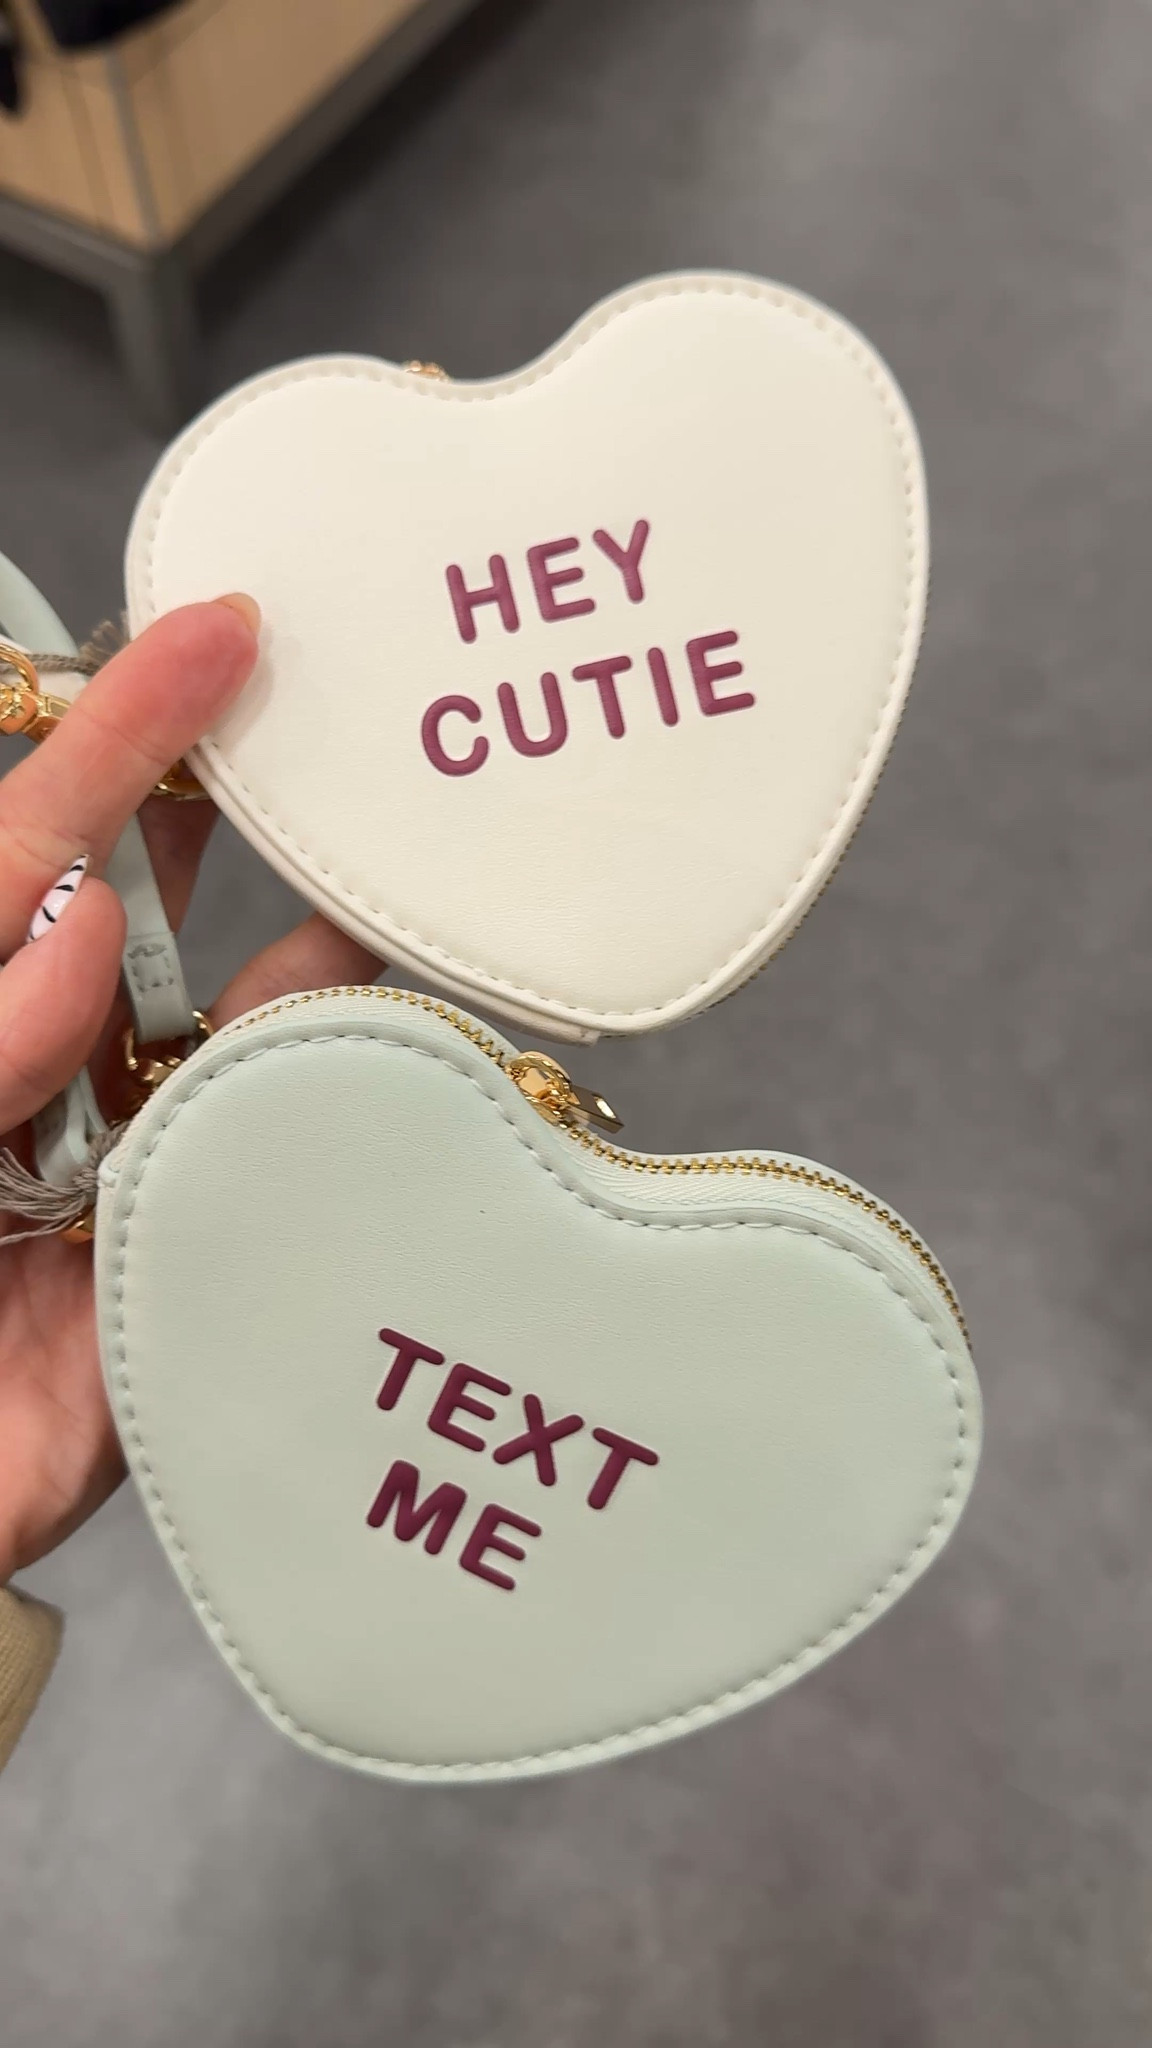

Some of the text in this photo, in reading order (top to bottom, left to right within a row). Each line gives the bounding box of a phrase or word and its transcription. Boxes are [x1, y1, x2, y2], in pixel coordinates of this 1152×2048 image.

[446, 519, 650, 643] HEY
[421, 630, 756, 777] CUTIE
[377, 1328, 659, 1510] TEXT
[367, 1460, 542, 1591] ME
